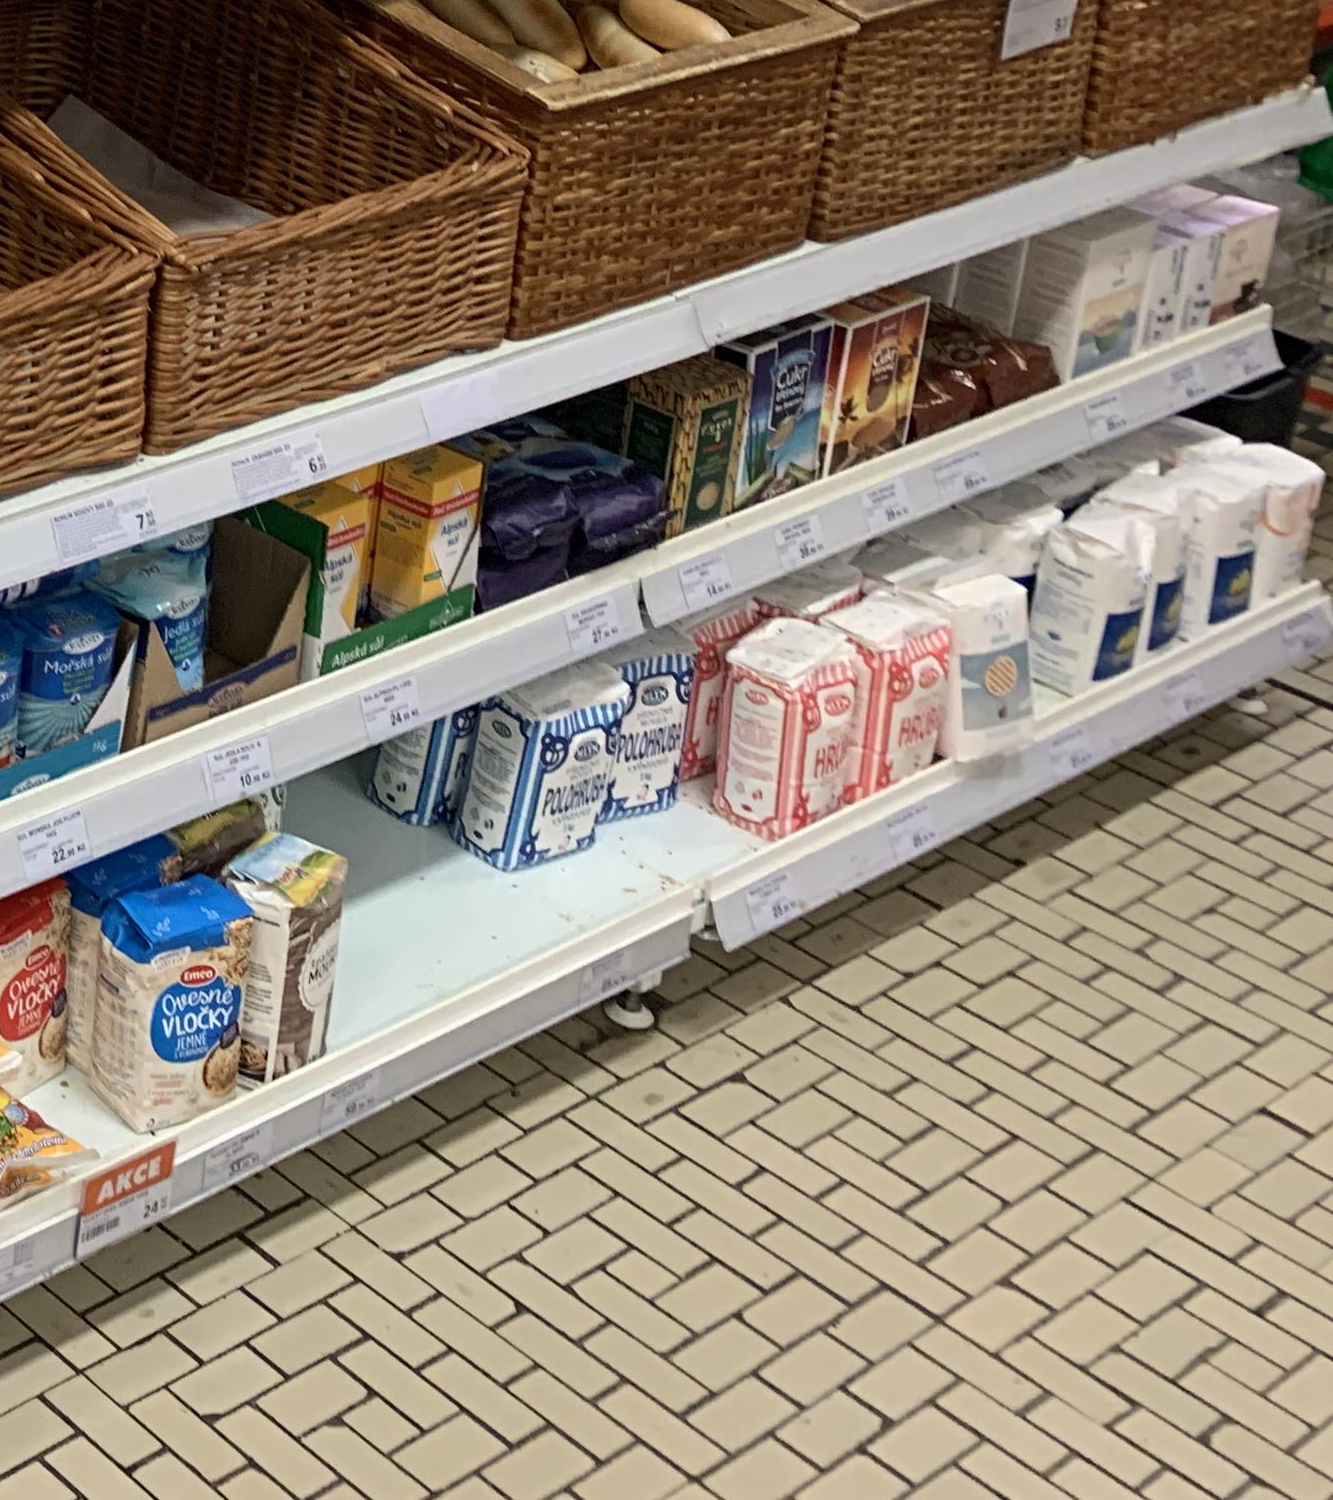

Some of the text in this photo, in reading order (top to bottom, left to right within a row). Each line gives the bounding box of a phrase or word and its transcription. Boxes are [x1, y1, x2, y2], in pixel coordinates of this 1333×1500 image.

[331, 644, 367, 667] Alpská
[7, 963, 60, 1002] Ovesné
[182, 969, 213, 982] Emco
[7, 982, 66, 1019] VLOČKY
[160, 991, 233, 1018] Ovesné
[162, 1007, 234, 1039] VLOČKY
[100, 1156, 163, 1201] AKCE
